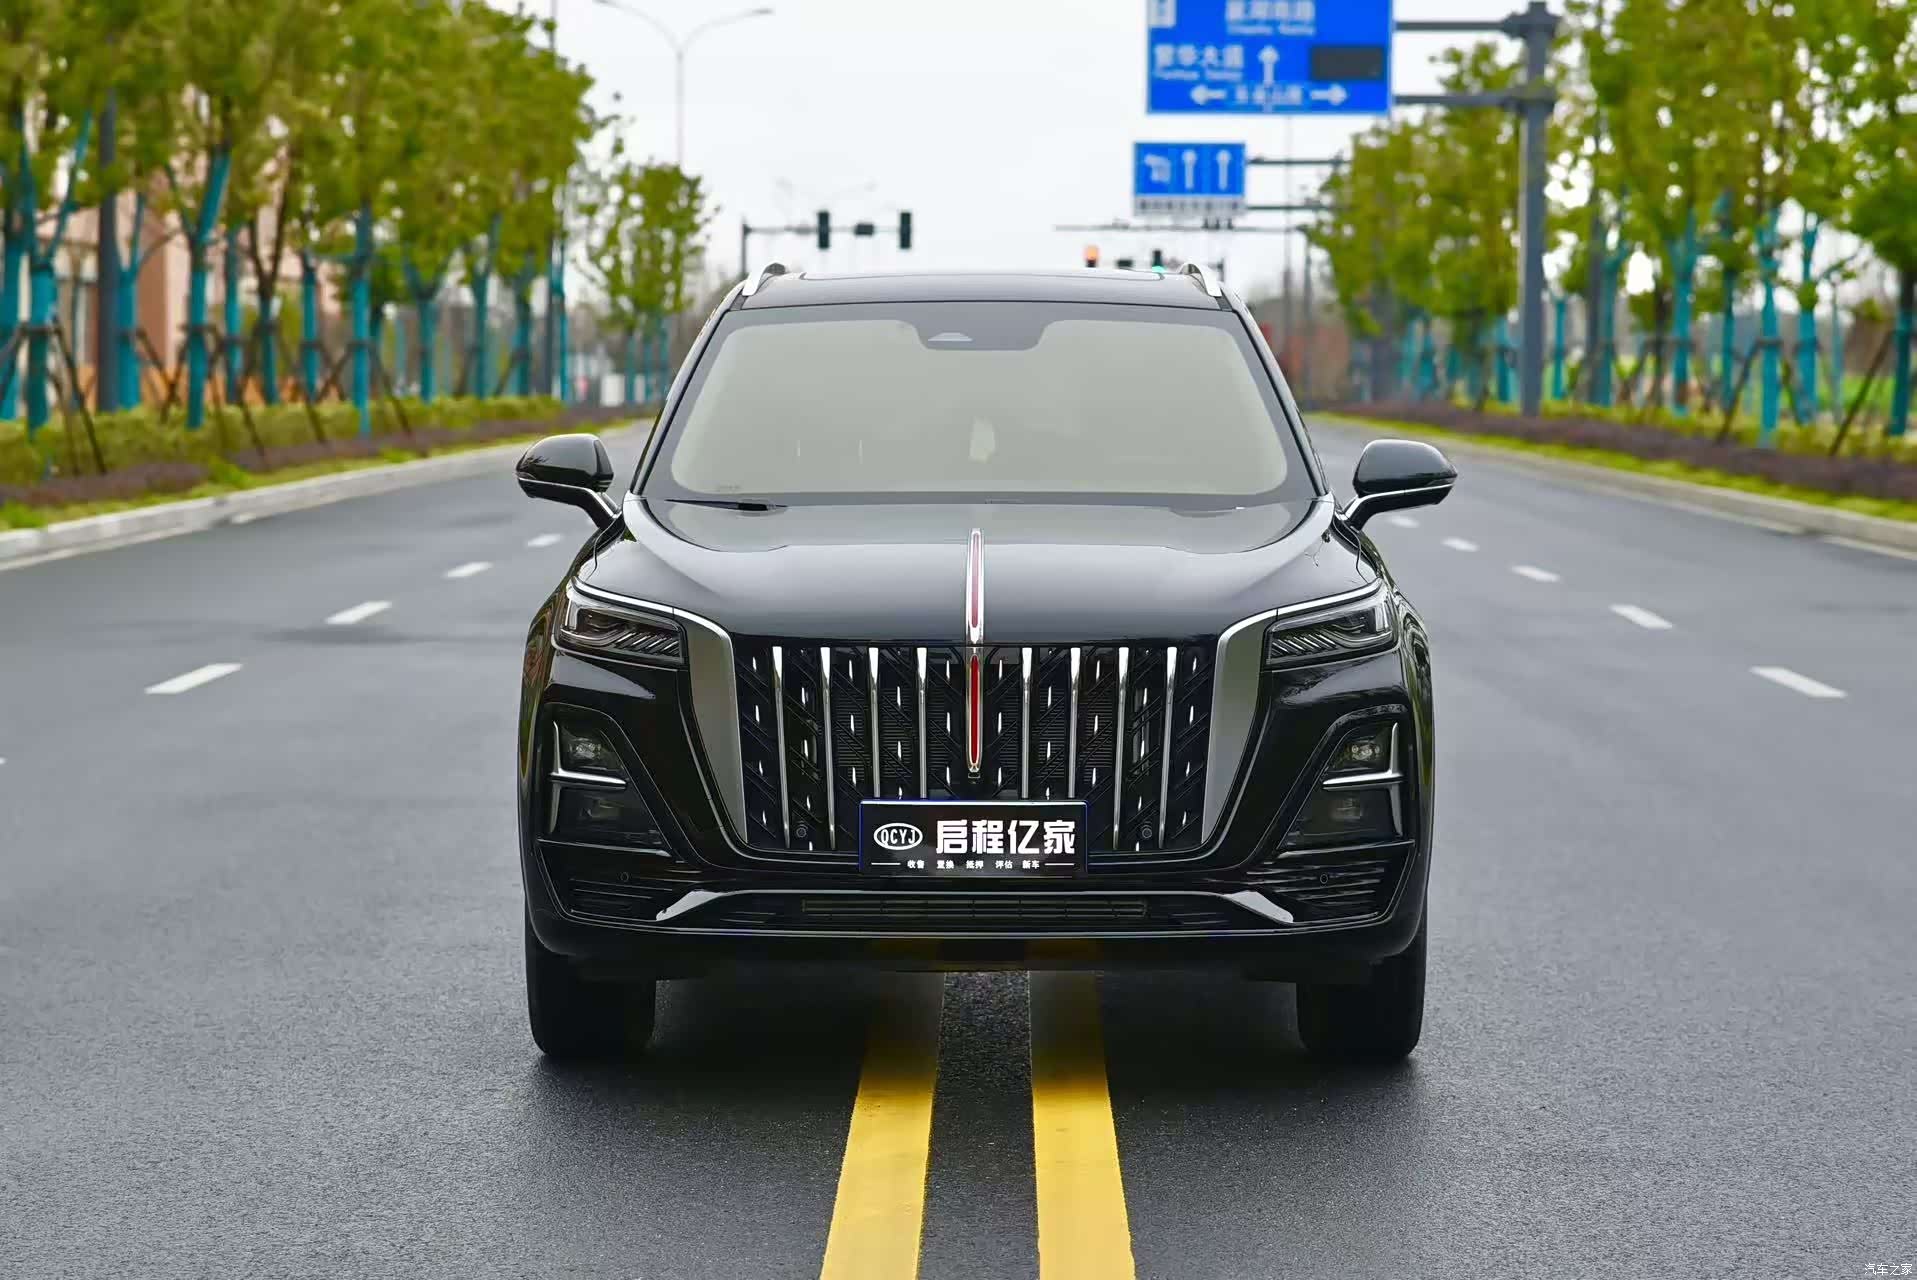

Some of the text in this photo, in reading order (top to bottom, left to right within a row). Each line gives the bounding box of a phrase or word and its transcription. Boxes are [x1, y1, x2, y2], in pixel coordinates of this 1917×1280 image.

[880, 829, 916, 846] QCYJ
[936, 819, 1075, 854] 启程亿家
[936, 860, 955, 869] 置换
[966, 860, 984, 869] 抵押
[995, 860, 1013, 869] 评估
[1022, 860, 1040, 869] 新车
